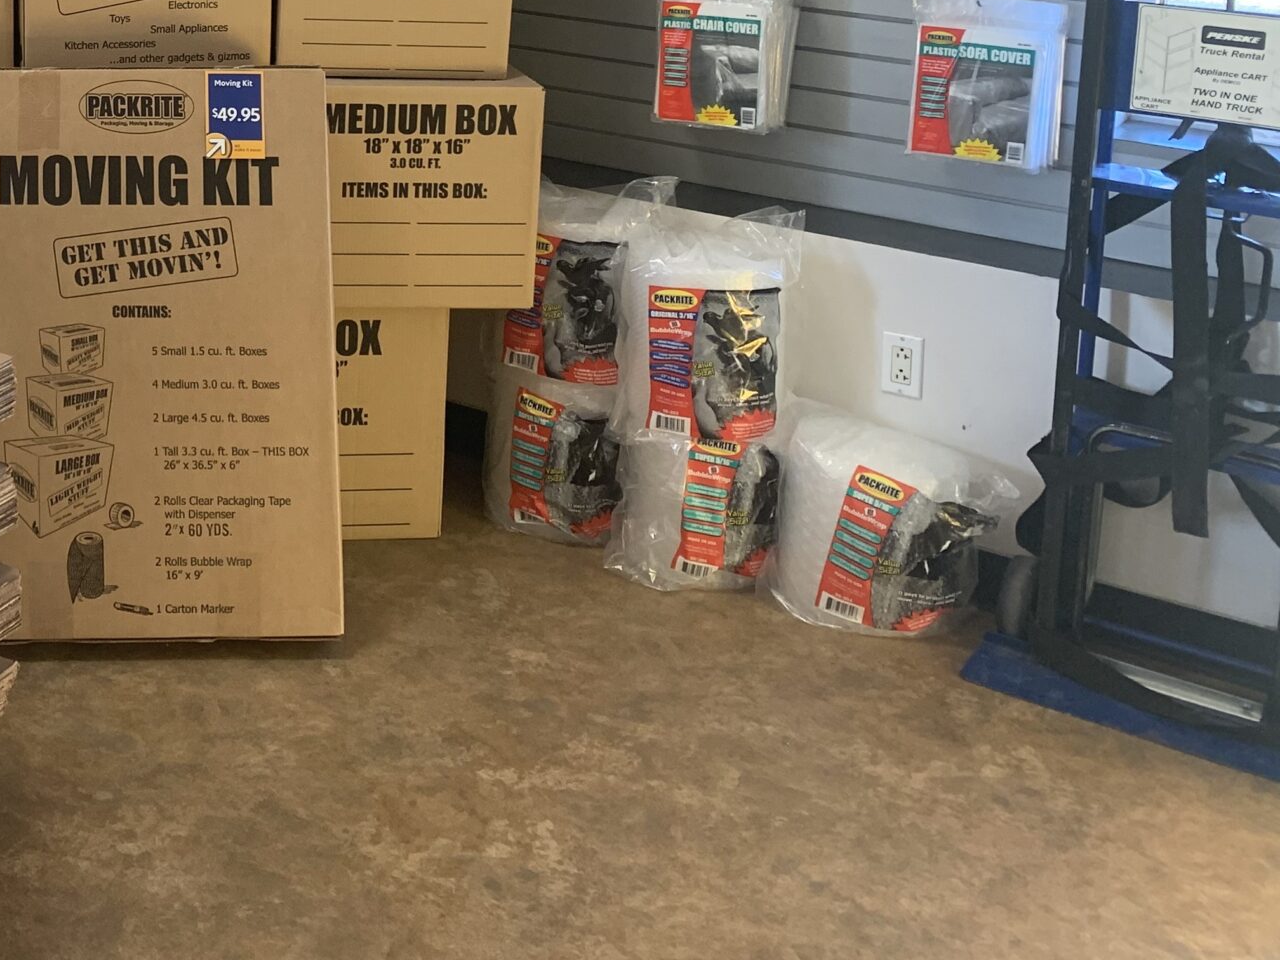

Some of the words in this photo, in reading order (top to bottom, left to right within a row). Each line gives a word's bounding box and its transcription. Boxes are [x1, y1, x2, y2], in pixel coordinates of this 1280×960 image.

[168, 0, 218, 9] Electronics
[110, 14, 131, 23] Toys
[150, 25, 175, 34] Small
[179, 24, 228, 34] Appliances
[664, 21, 691, 29] PLASTIC
[693, 19, 724, 32] CHAIR
[725, 22, 758, 35] COVER
[64, 41, 99, 50] Kitchen
[102, 39, 156, 49] Accessories
[1205, 31, 1262, 44] PENSKE
[923, 46, 958, 57] PLASTIC
[959, 46, 988, 60] SOFA
[991, 50, 1031, 65] COVER
[1200, 46, 1227, 57] Truck
[1231, 51, 1265, 61] Rental
[1194, 66, 1238, 78] Appliance
[1241, 72, 1268, 81] CART
[214, 80, 241, 88] Moving
[1134, 95, 1171, 105] APPLIANCE
[1193, 88, 1217, 97] TWO
[1220, 91, 1231, 99] IN
[1234, 93, 1258, 103] ONE
[87, 94, 185, 119] PACKRITE
[1191, 99, 1222, 109] HAND
[1226, 102, 1263, 114] TRUCK
[212, 107, 260, 122] $49.95
[326, 103, 446, 135] MEDIUM
[455, 104, 518, 135] BOX
[202, 155, 279, 207] KIT
[61, 242, 106, 266] GET
[113, 233, 172, 260] THIS
[180, 226, 229, 251] AND
[74, 263, 120, 288] GET
[654, 294, 694, 305] PACKRITE
[112, 305, 172, 320] CONTAINS:
[152, 346, 157, 356] 5
[161, 346, 187, 356] Small
[191, 346, 205, 356] 1.5
[208, 348, 222, 356] cu.
[225, 346, 236, 356] ft.
[239, 346, 268, 356] Boxes
[857, 474, 901, 499] PACKRITE
[154, 496, 160, 506] 2
[164, 496, 186, 506] Rolls
[189, 496, 214, 506] Clear
[217, 496, 265, 508] Packaging
[269, 496, 291, 507] Tape
[165, 509, 185, 519] with
[188, 510, 236, 521] Dispenser
[157, 604, 161, 614] 1
[165, 604, 197, 614] Carton
[201, 604, 234, 614] Marker
